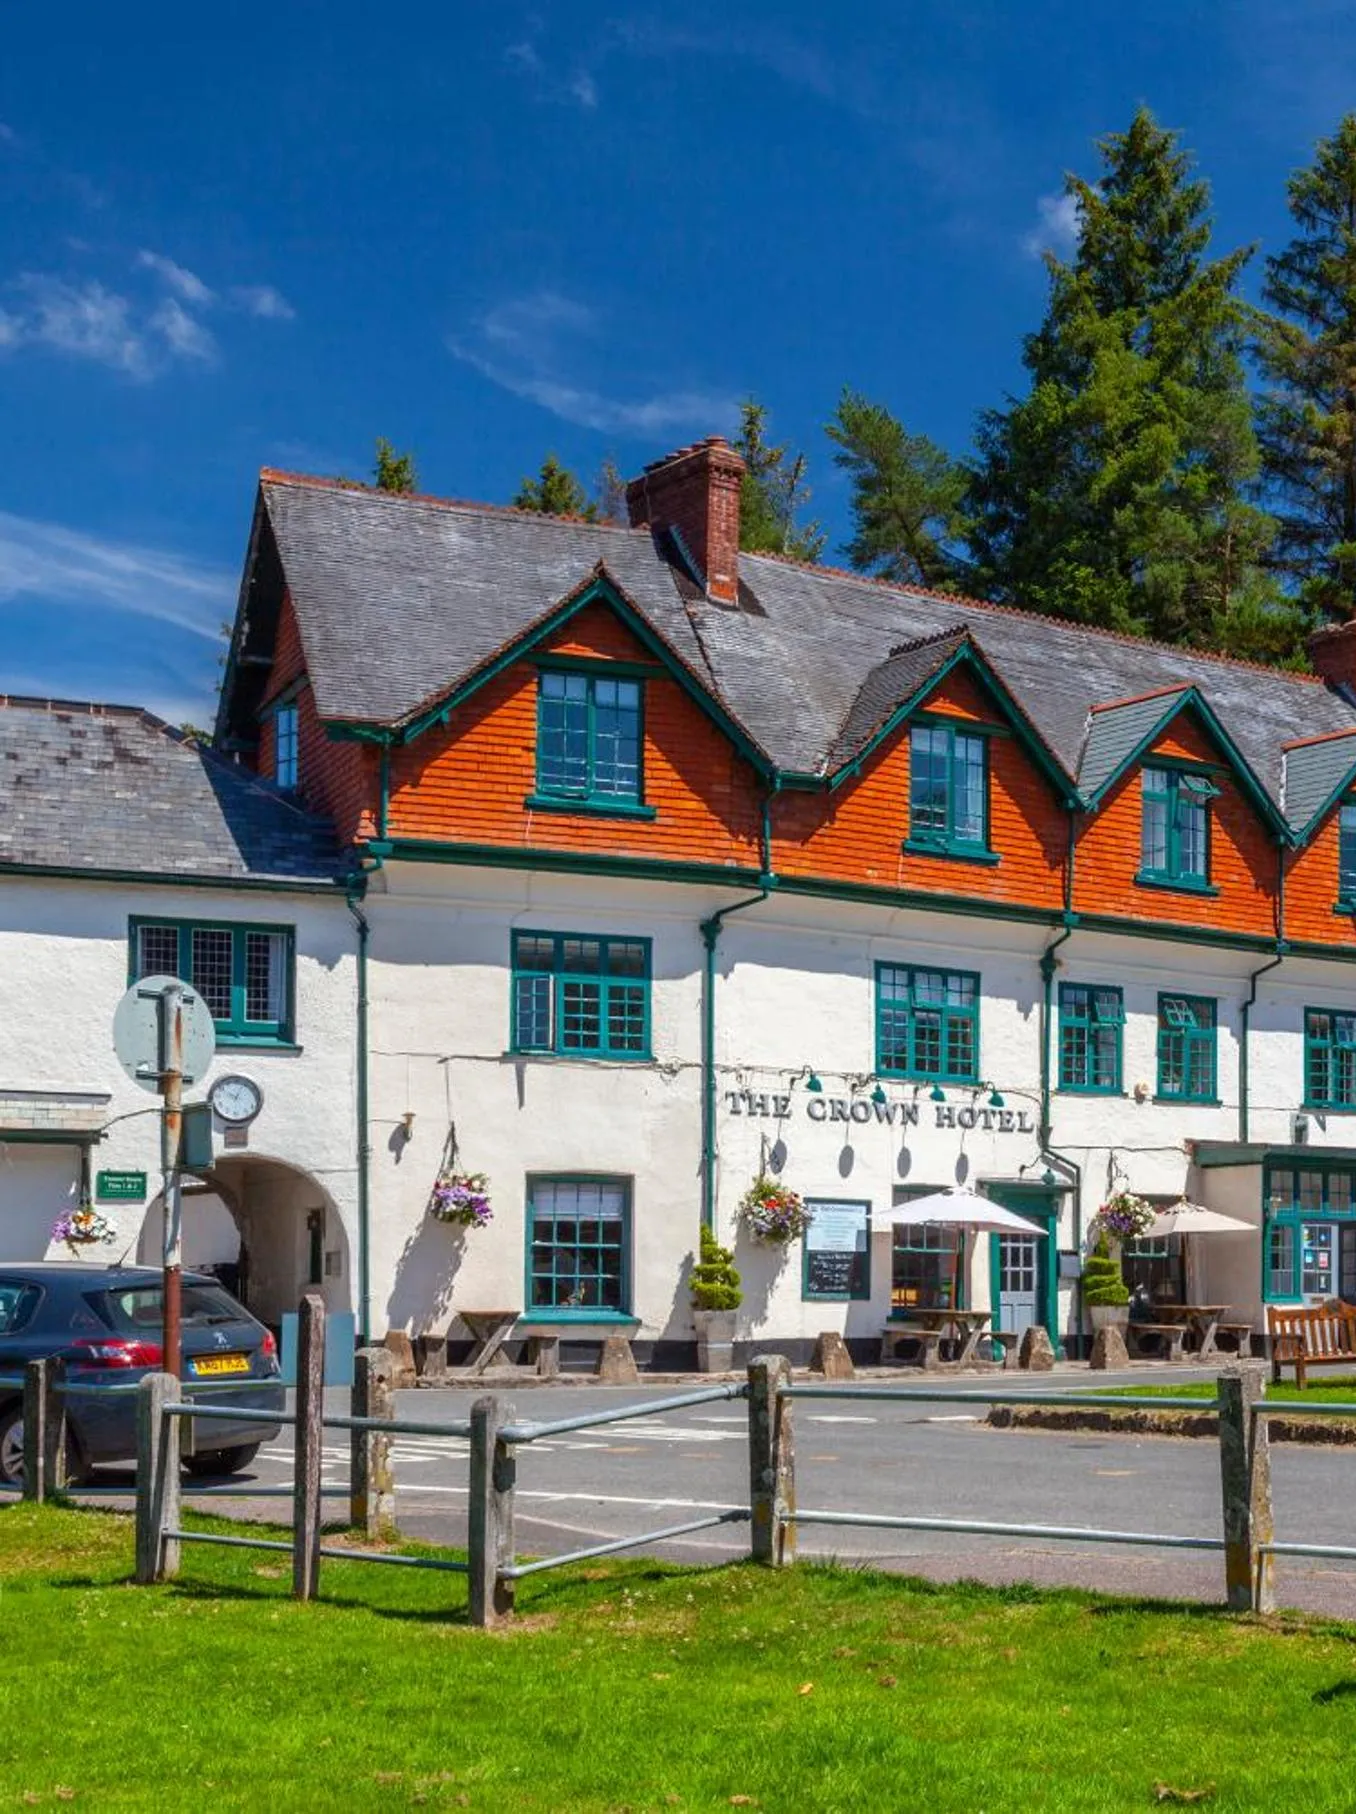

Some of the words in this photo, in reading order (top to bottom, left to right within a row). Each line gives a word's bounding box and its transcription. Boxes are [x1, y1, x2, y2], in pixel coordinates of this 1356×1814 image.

[724, 1090, 792, 1119] THE
[806, 1098, 920, 1126] CROWN
[934, 1105, 1035, 1132] HOTEL
